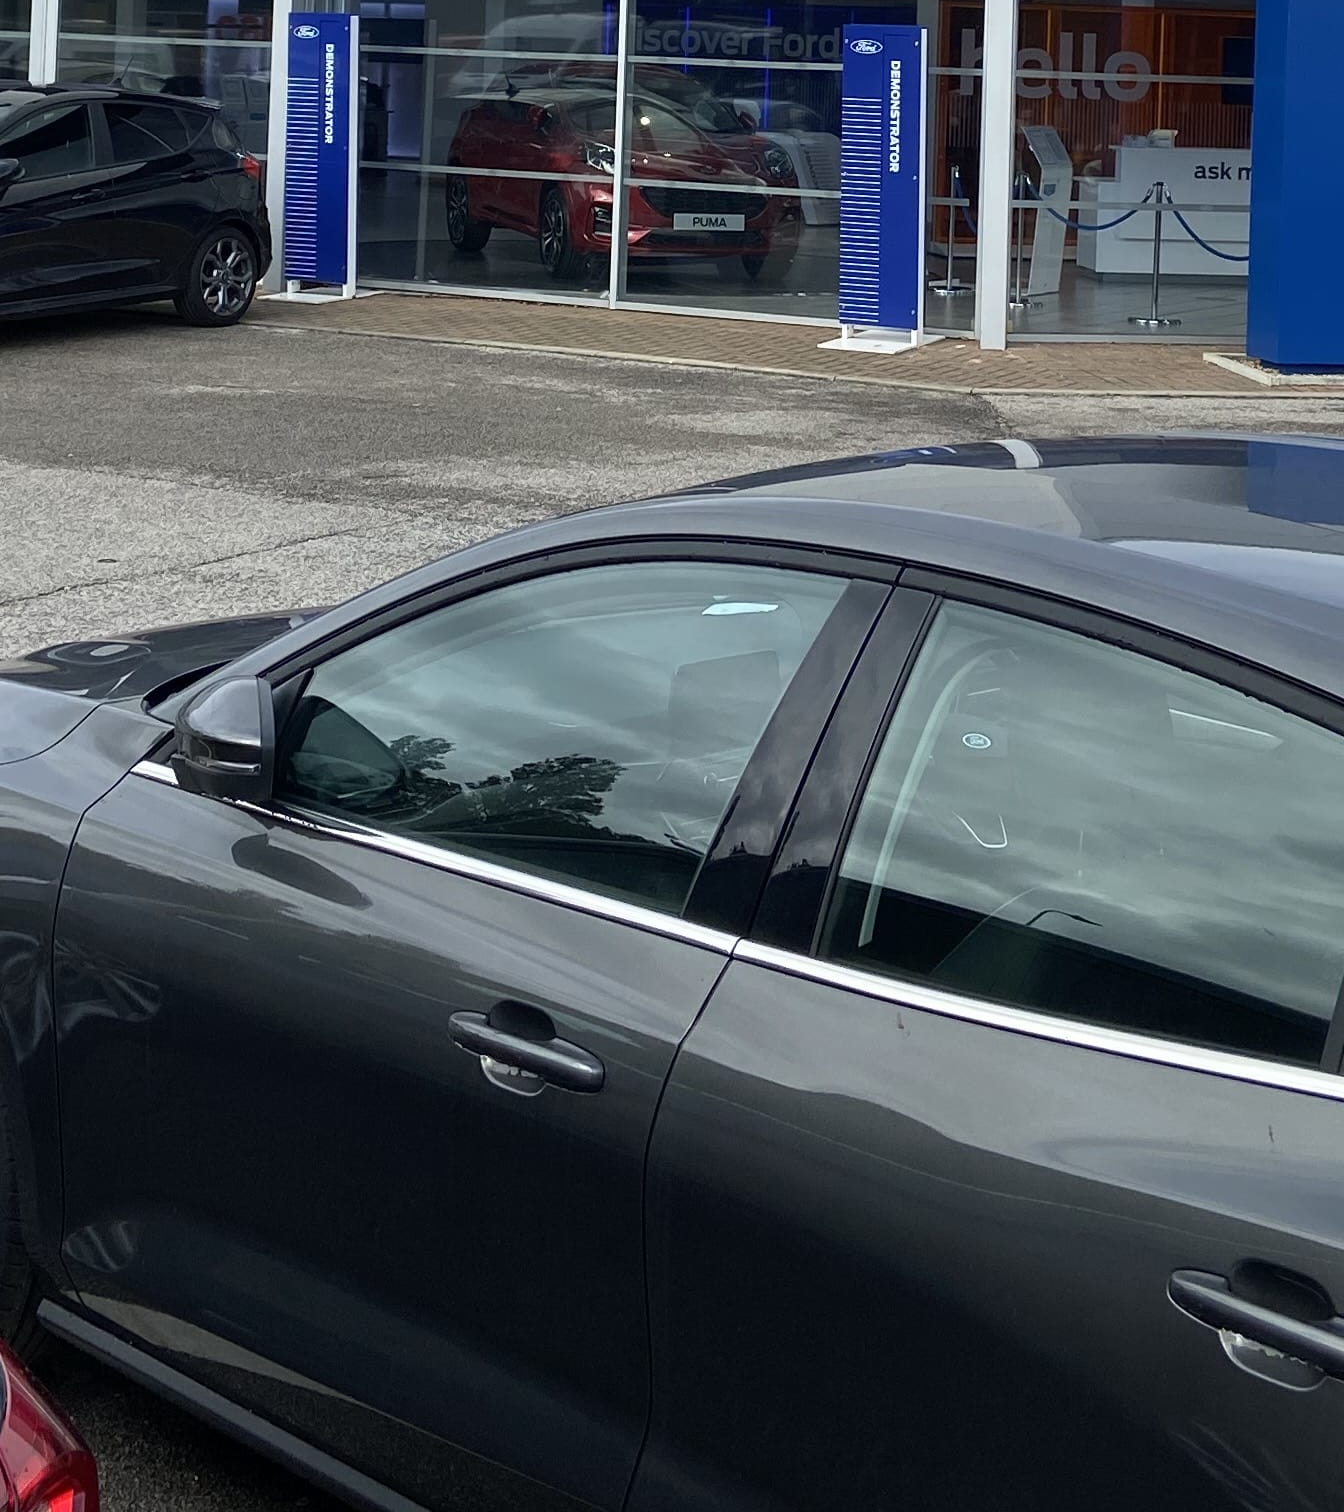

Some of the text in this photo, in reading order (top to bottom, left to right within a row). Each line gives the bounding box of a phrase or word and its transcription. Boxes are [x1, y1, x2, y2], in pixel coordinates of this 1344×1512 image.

[636, 26, 754, 56] iscover
[324, 43, 335, 144] DEMONSTRATOR
[889, 60, 901, 173] DEMONSTRATOR
[1194, 161, 1232, 180] ask
[692, 216, 727, 228] PUMA
